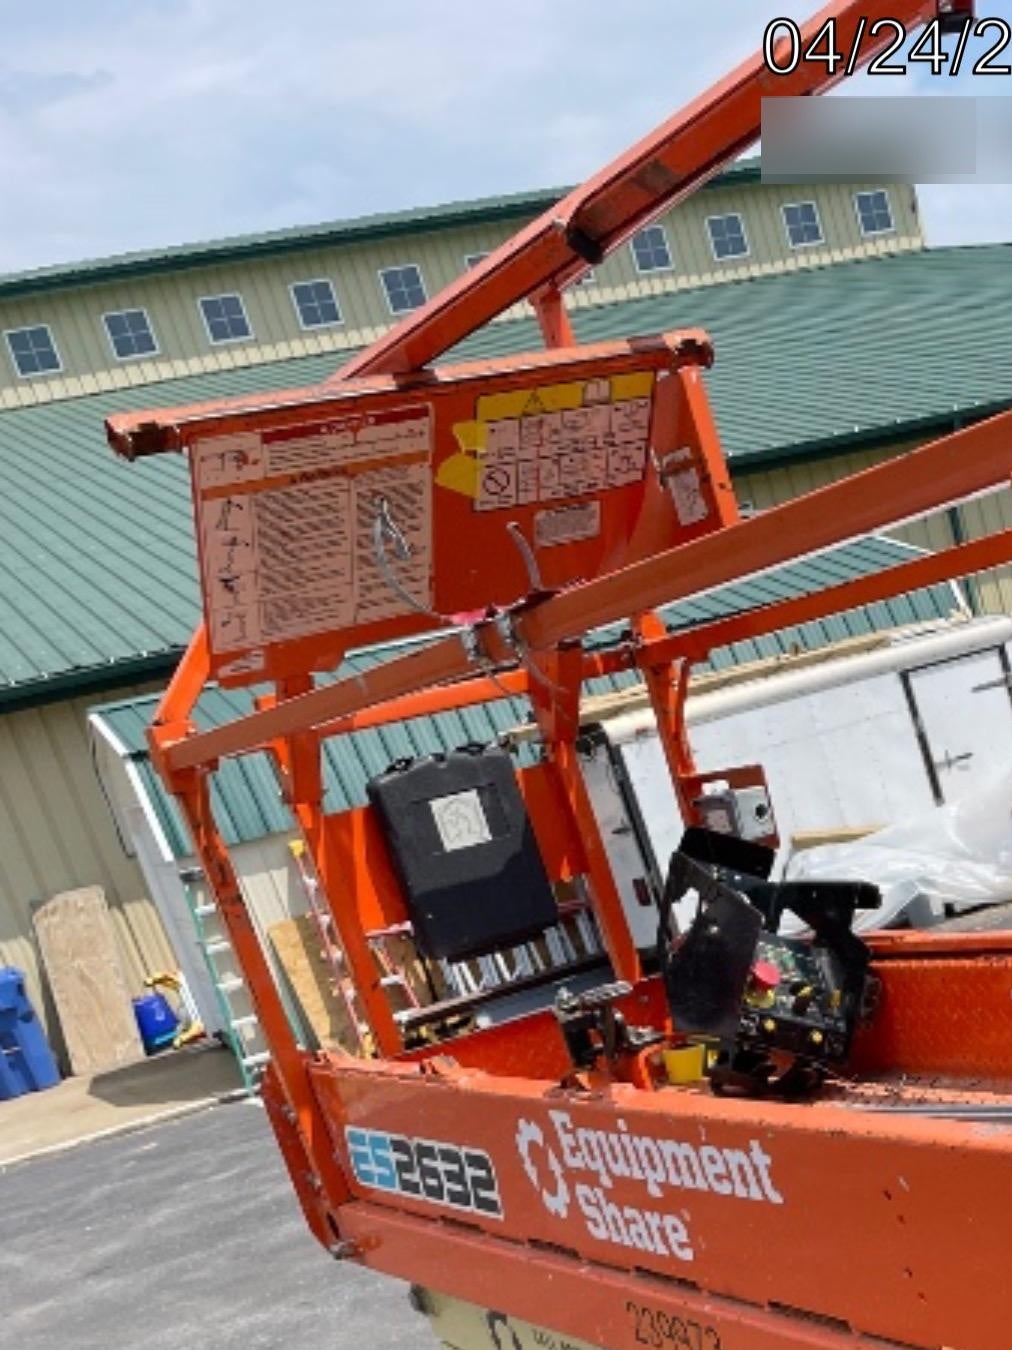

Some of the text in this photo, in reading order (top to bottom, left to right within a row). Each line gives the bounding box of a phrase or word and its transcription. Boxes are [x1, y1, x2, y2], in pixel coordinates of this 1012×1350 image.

[346, 1126, 503, 1220] ES2632
[548, 1109, 784, 1204] Equipment
[575, 1174, 695, 1262] Share
